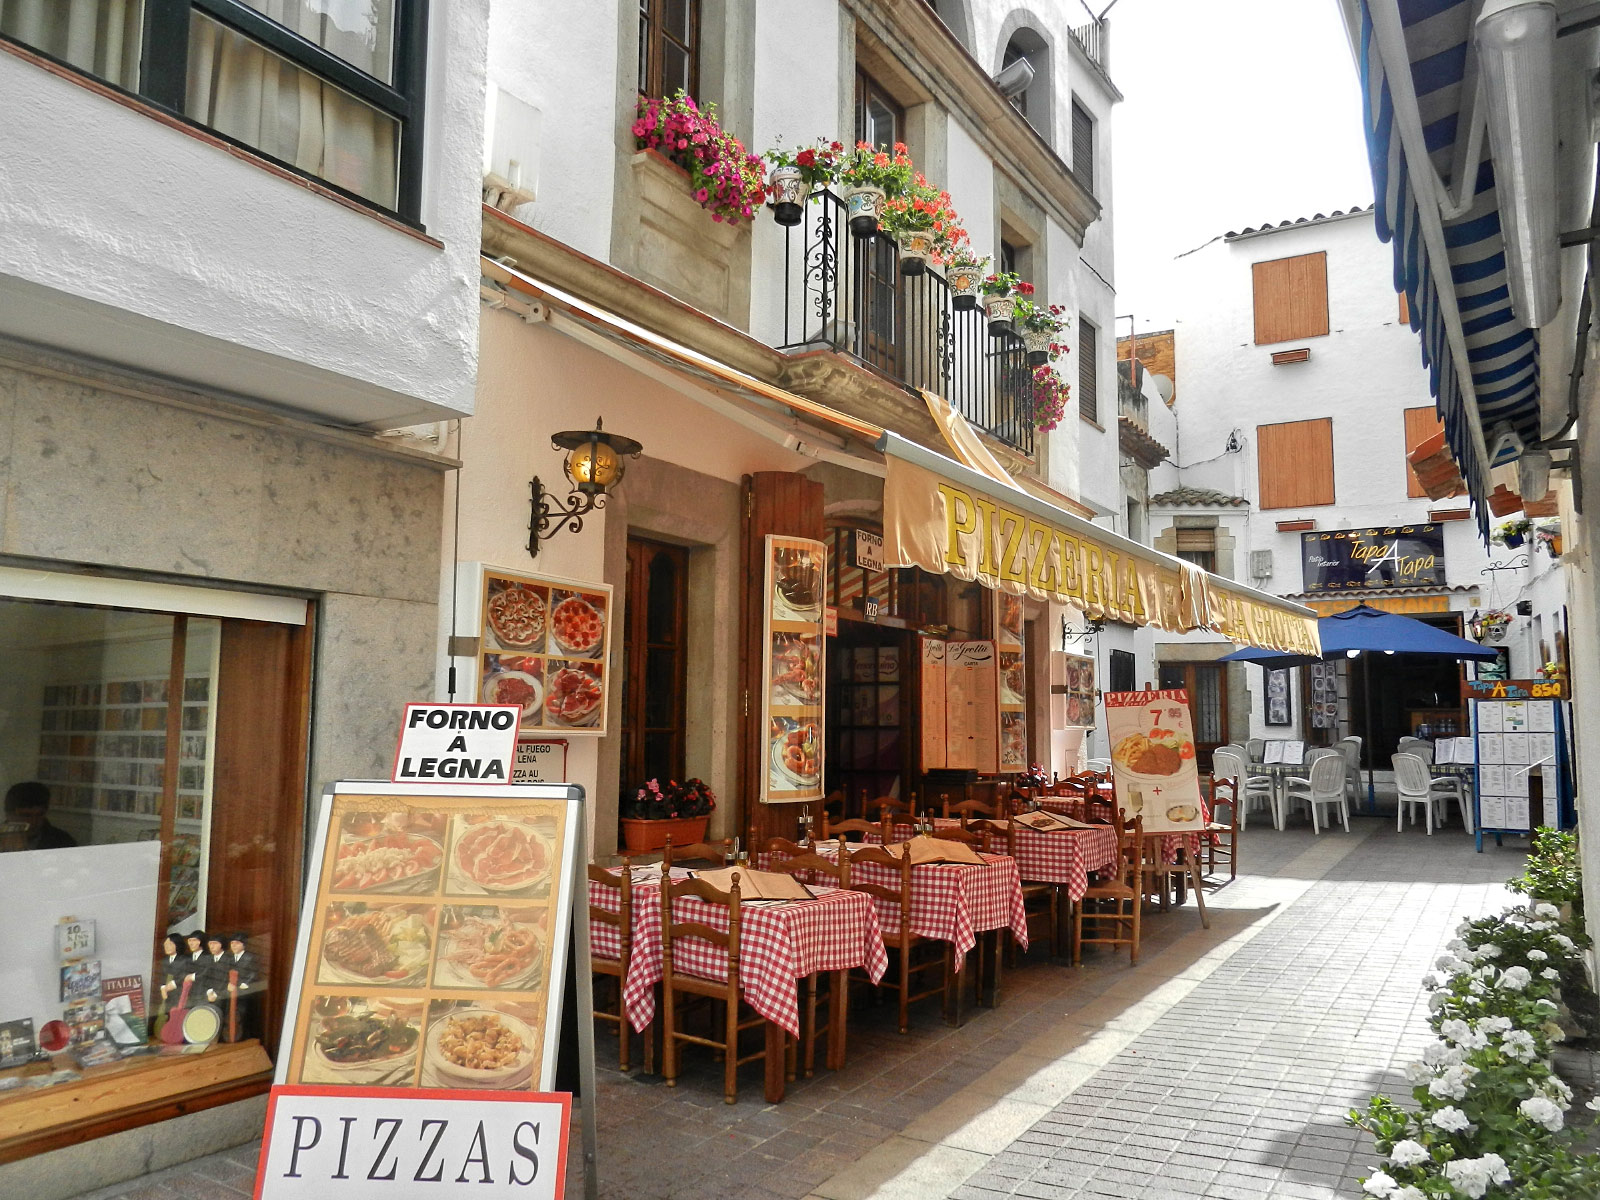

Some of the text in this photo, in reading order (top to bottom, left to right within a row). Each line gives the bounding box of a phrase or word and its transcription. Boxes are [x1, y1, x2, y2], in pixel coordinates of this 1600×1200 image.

[857, 530, 883, 547] FORNO
[867, 546, 873, 556] A
[939, 483, 1145, 616] PIZZERIA
[857, 555, 882, 571] LEGNA
[1350, 539, 1435, 578] Tapa A Tapa
[866, 602, 878, 617] RB
[1106, 689, 1187, 703] PIZZERIA
[1468, 680, 1494, 693] Tapa
[1491, 681, 1507, 697] A
[408, 709, 515, 731] FORNO
[526, 745, 551, 753] FUEGO
[400, 757, 505, 779] LEGNA
[513, 769, 539, 778] ZZA AU
[283, 1115, 541, 1186] PIZZAS
